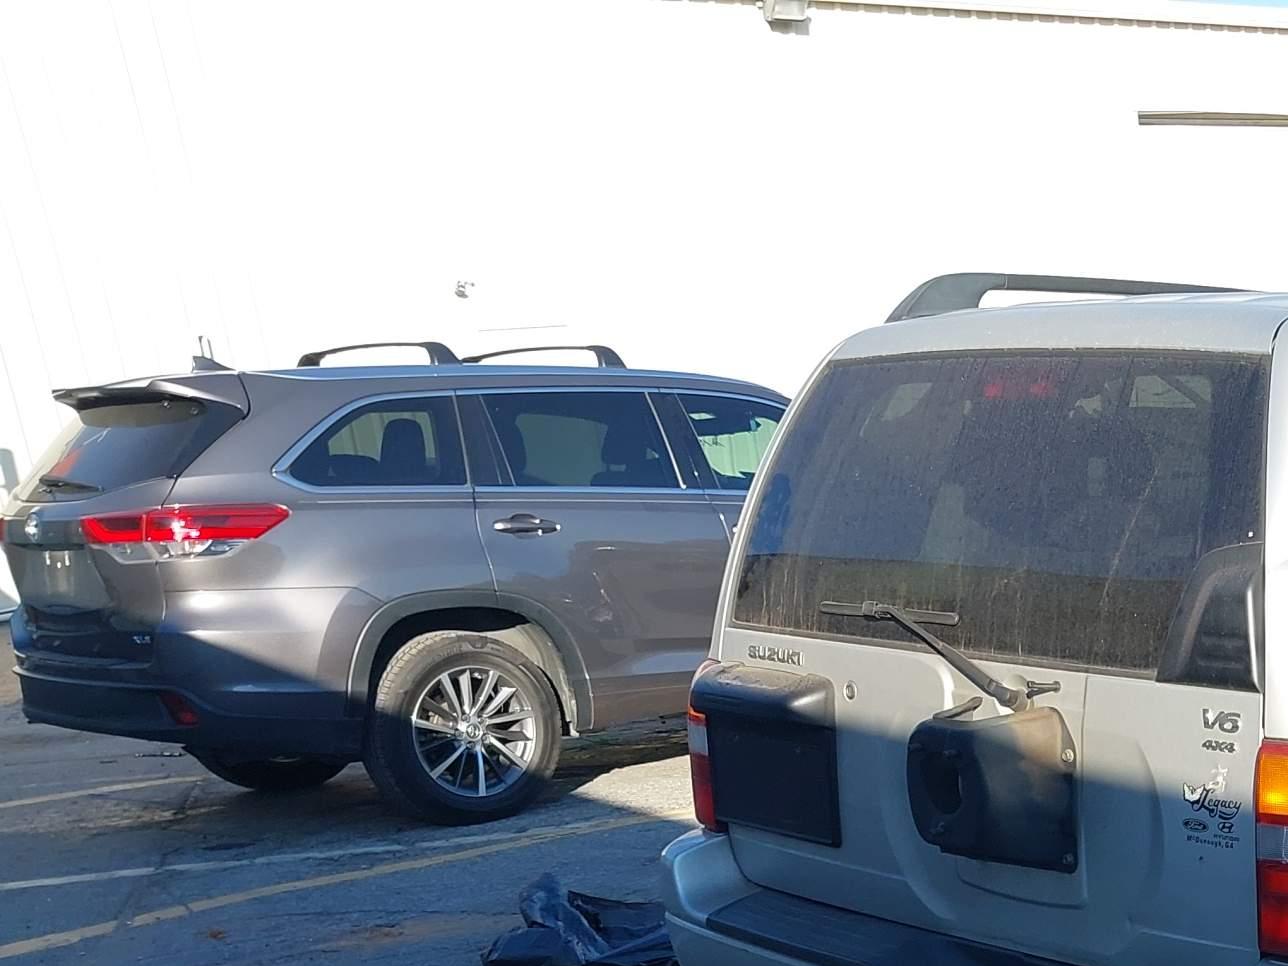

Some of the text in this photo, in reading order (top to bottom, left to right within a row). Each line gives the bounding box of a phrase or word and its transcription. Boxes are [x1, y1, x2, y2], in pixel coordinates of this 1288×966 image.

[748, 645, 804, 666] SUZUKI
[1202, 708, 1241, 734] V6
[1192, 787, 1242, 820] Legacy
